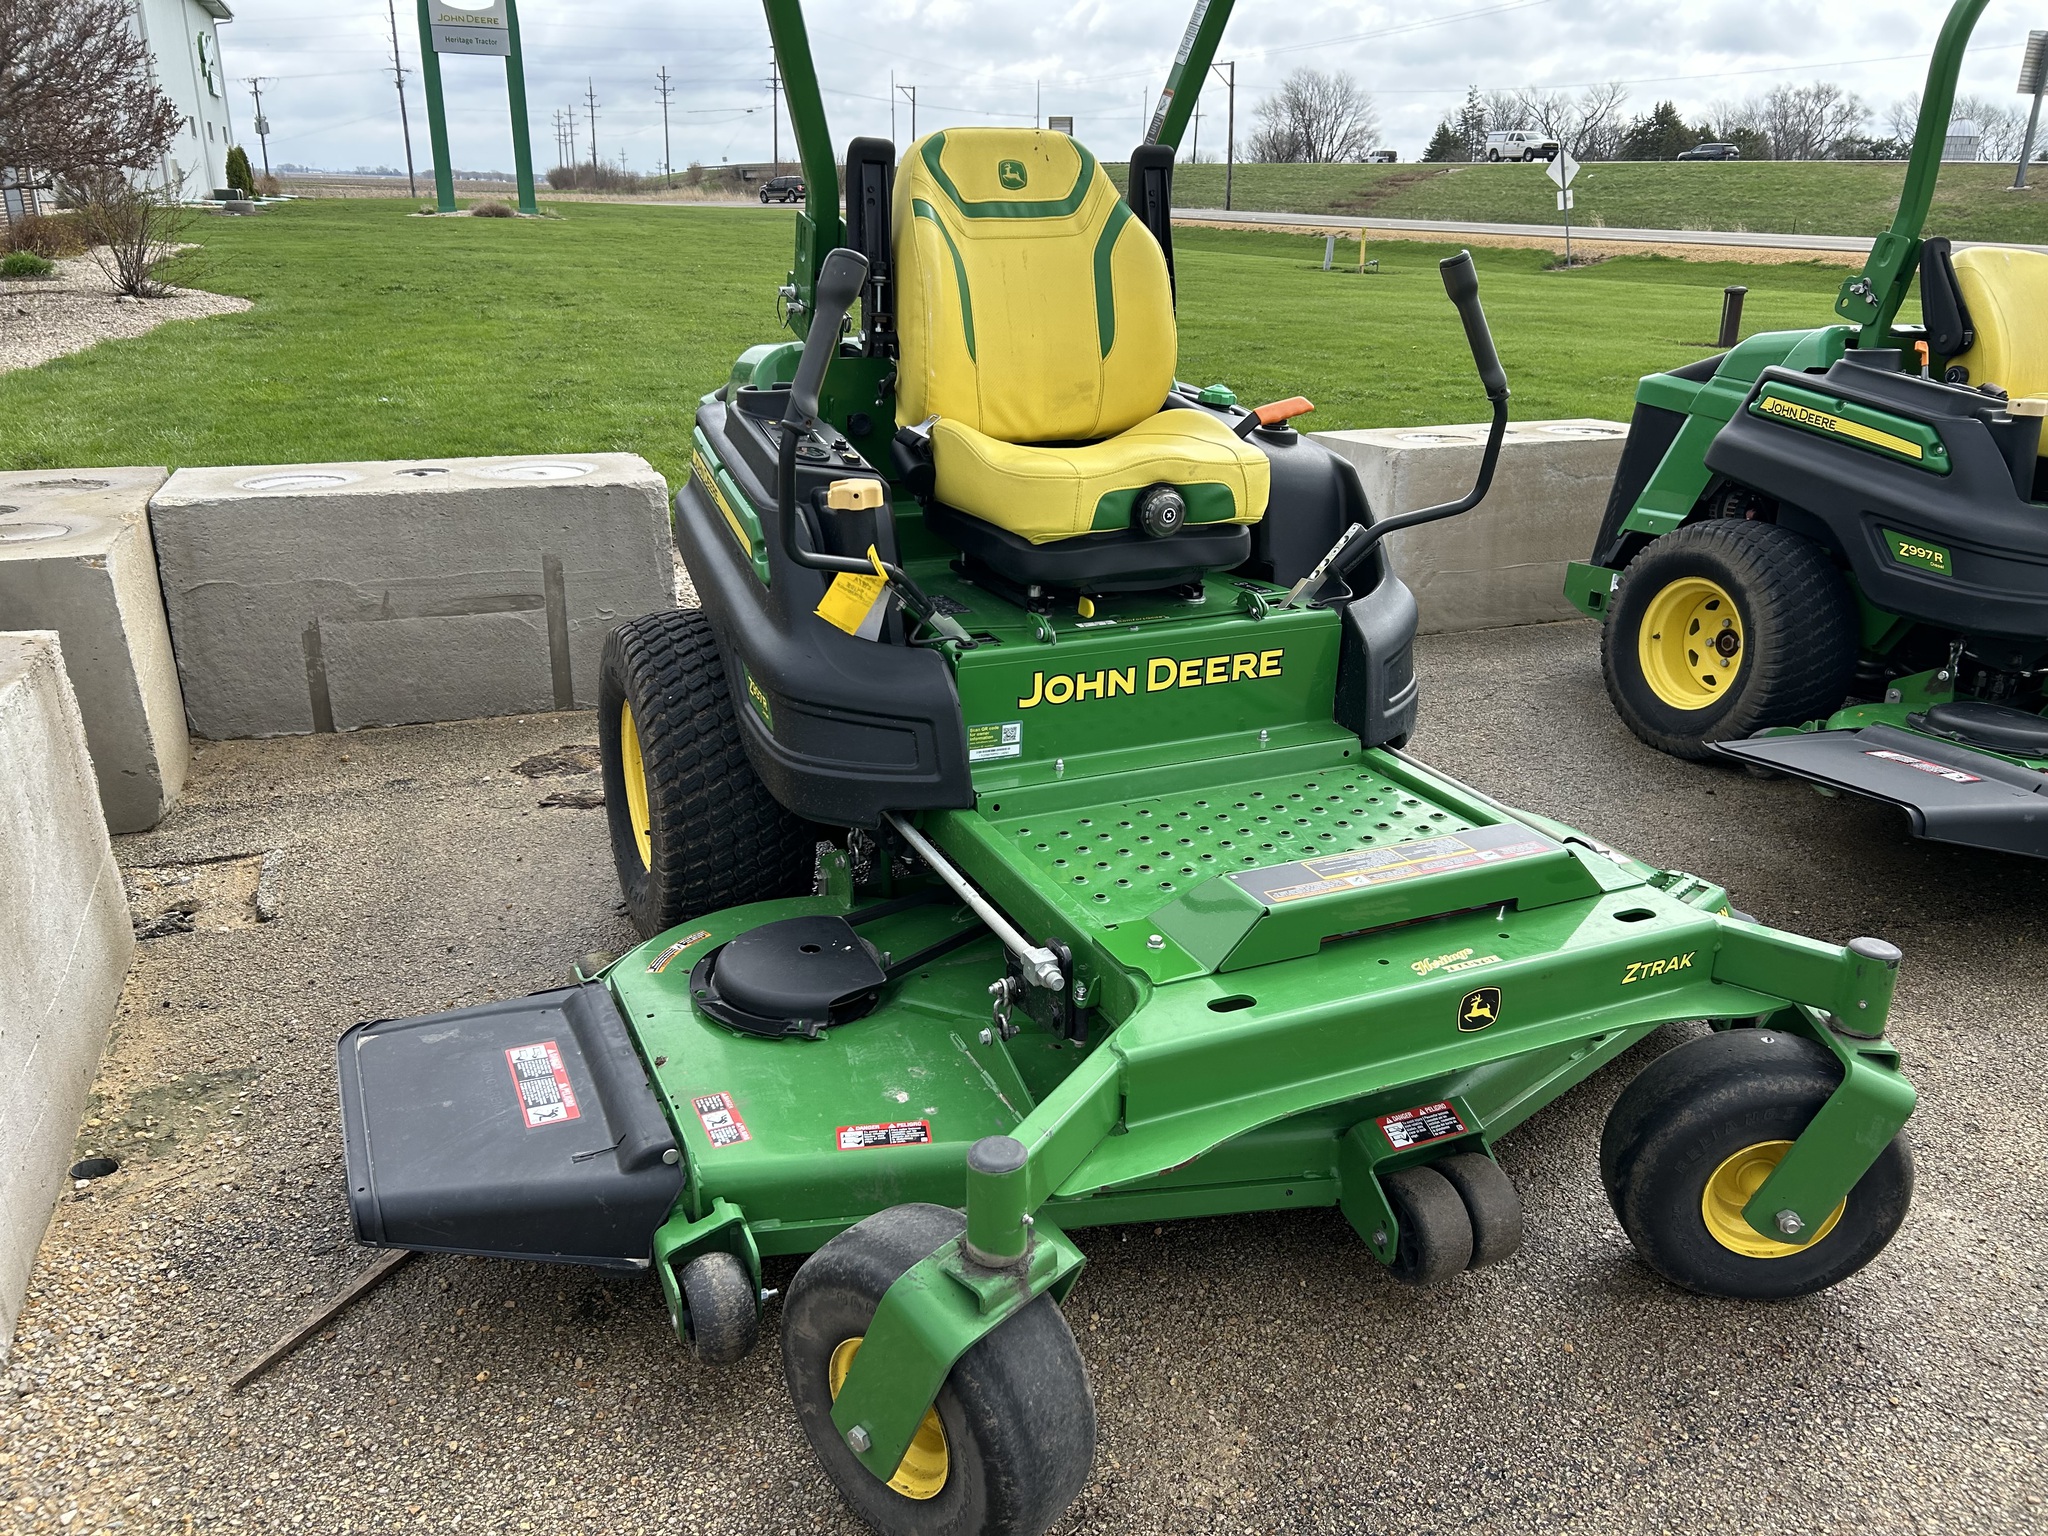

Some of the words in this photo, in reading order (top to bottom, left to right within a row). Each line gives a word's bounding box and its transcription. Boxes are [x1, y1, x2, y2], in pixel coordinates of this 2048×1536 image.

[437, 13, 465, 22] JOHN
[466, 14, 500, 25] DEERE
[444, 36, 473, 45] Heritage
[475, 37, 498, 46] Tractor
[1768, 400, 1797, 419] JOHN
[1799, 408, 1838, 430] DEERE
[1018, 665, 1137, 709] JOHN
[1146, 648, 1285, 693] DEERE
[1411, 947, 1474, 976] Heritage
[1620, 950, 1697, 985] ZTRAK
[1391, 1111, 1413, 1122] DANGER
[1424, 1103, 1447, 1114] PELIGRO
